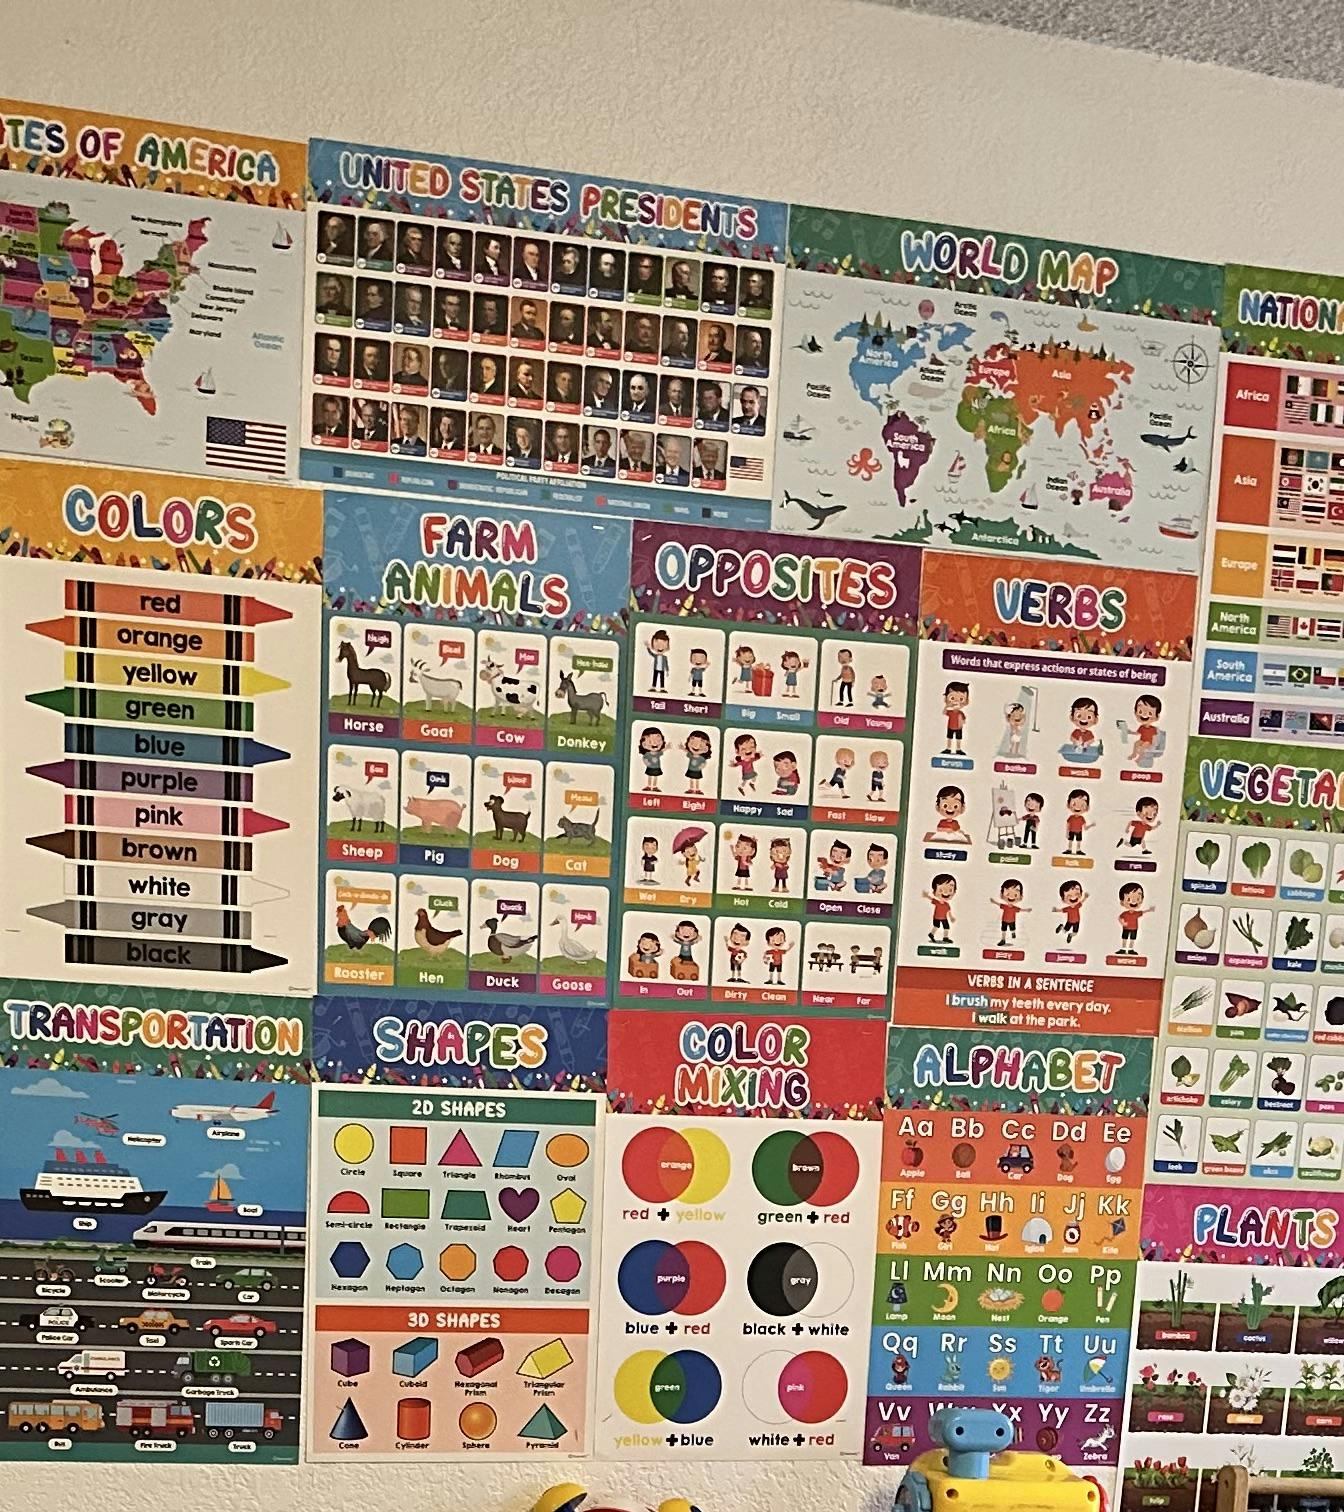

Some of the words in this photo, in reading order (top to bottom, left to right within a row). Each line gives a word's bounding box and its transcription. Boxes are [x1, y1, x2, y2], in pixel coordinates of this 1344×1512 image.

[75, 124, 124, 162] OF
[134, 132, 279, 186] AMERICA
[337, 150, 452, 198] UNITED
[458, 167, 571, 215] STATES
[579, 184, 758, 240] PRESIDENTS
[900, 231, 1028, 285] WORLD
[1035, 249, 1118, 298] MAP
[1235, 389, 1270, 402] Africa
[61, 484, 258, 553] COLORS
[419, 512, 538, 566] FARM
[654, 541, 897, 609] OPPOSITES
[381, 558, 571, 619] ANIMALS
[139, 594, 180, 615] red
[992, 578, 1126, 633] VERBS
[117, 626, 202, 654] orange
[122, 663, 198, 687] yellow
[1217, 659, 1245, 671] South
[1207, 671, 1253, 683] America
[125, 699, 195, 721] green
[1203, 711, 1249, 724] Australia
[343, 718, 384, 734] Horse
[420, 724, 453, 738] Goat
[134, 734, 185, 757] blue
[496, 731, 525, 745] Cow
[557, 736, 606, 751] Donkey
[120, 771, 198, 794] purple
[134, 805, 183, 828] pink
[121, 838, 197, 862] brown
[127, 876, 191, 897] white
[130, 909, 187, 933] gray
[125, 942, 192, 964] black
[486, 975, 519, 989] Duck
[967, 974, 1005, 989] VERBS
[1008, 975, 1022, 989] IN
[1024, 977, 1033, 990] A
[1035, 977, 1094, 993] SENTENCE
[951, 994, 989, 1008] brush
[989, 998, 1009, 1012] my
[1011, 996, 1045, 1011] teeth
[1046, 1000, 1083, 1014] every
[1085, 1000, 1111, 1015] day.
[2, 998, 303, 1057] TRANSPORTATION
[978, 1012, 1007, 1024] walk
[1009, 1014, 1024, 1025] at
[1026, 1013, 1045, 1026] the
[1047, 1014, 1081, 1029] park.
[372, 1016, 548, 1071] SHAPES
[679, 1020, 811, 1067] COLOR
[913, 1042, 1125, 1094] ALPHABET
[674, 1062, 810, 1110] MIXING
[411, 1100, 433, 1116] 2D
[440, 1101, 507, 1118] SHAPES
[898, 1116, 933, 1138] Aa
[950, 1117, 984, 1139] Bb
[1001, 1119, 1035, 1140] Cc
[1051, 1121, 1087, 1142] Dd
[1102, 1122, 1131, 1143] Ee
[757, 1211, 802, 1225] green
[823, 1211, 849, 1223] red
[1194, 1203, 1339, 1249] PLANTS
[407, 1312, 429, 1328] 3D
[436, 1313, 500, 1329] SHAPES
